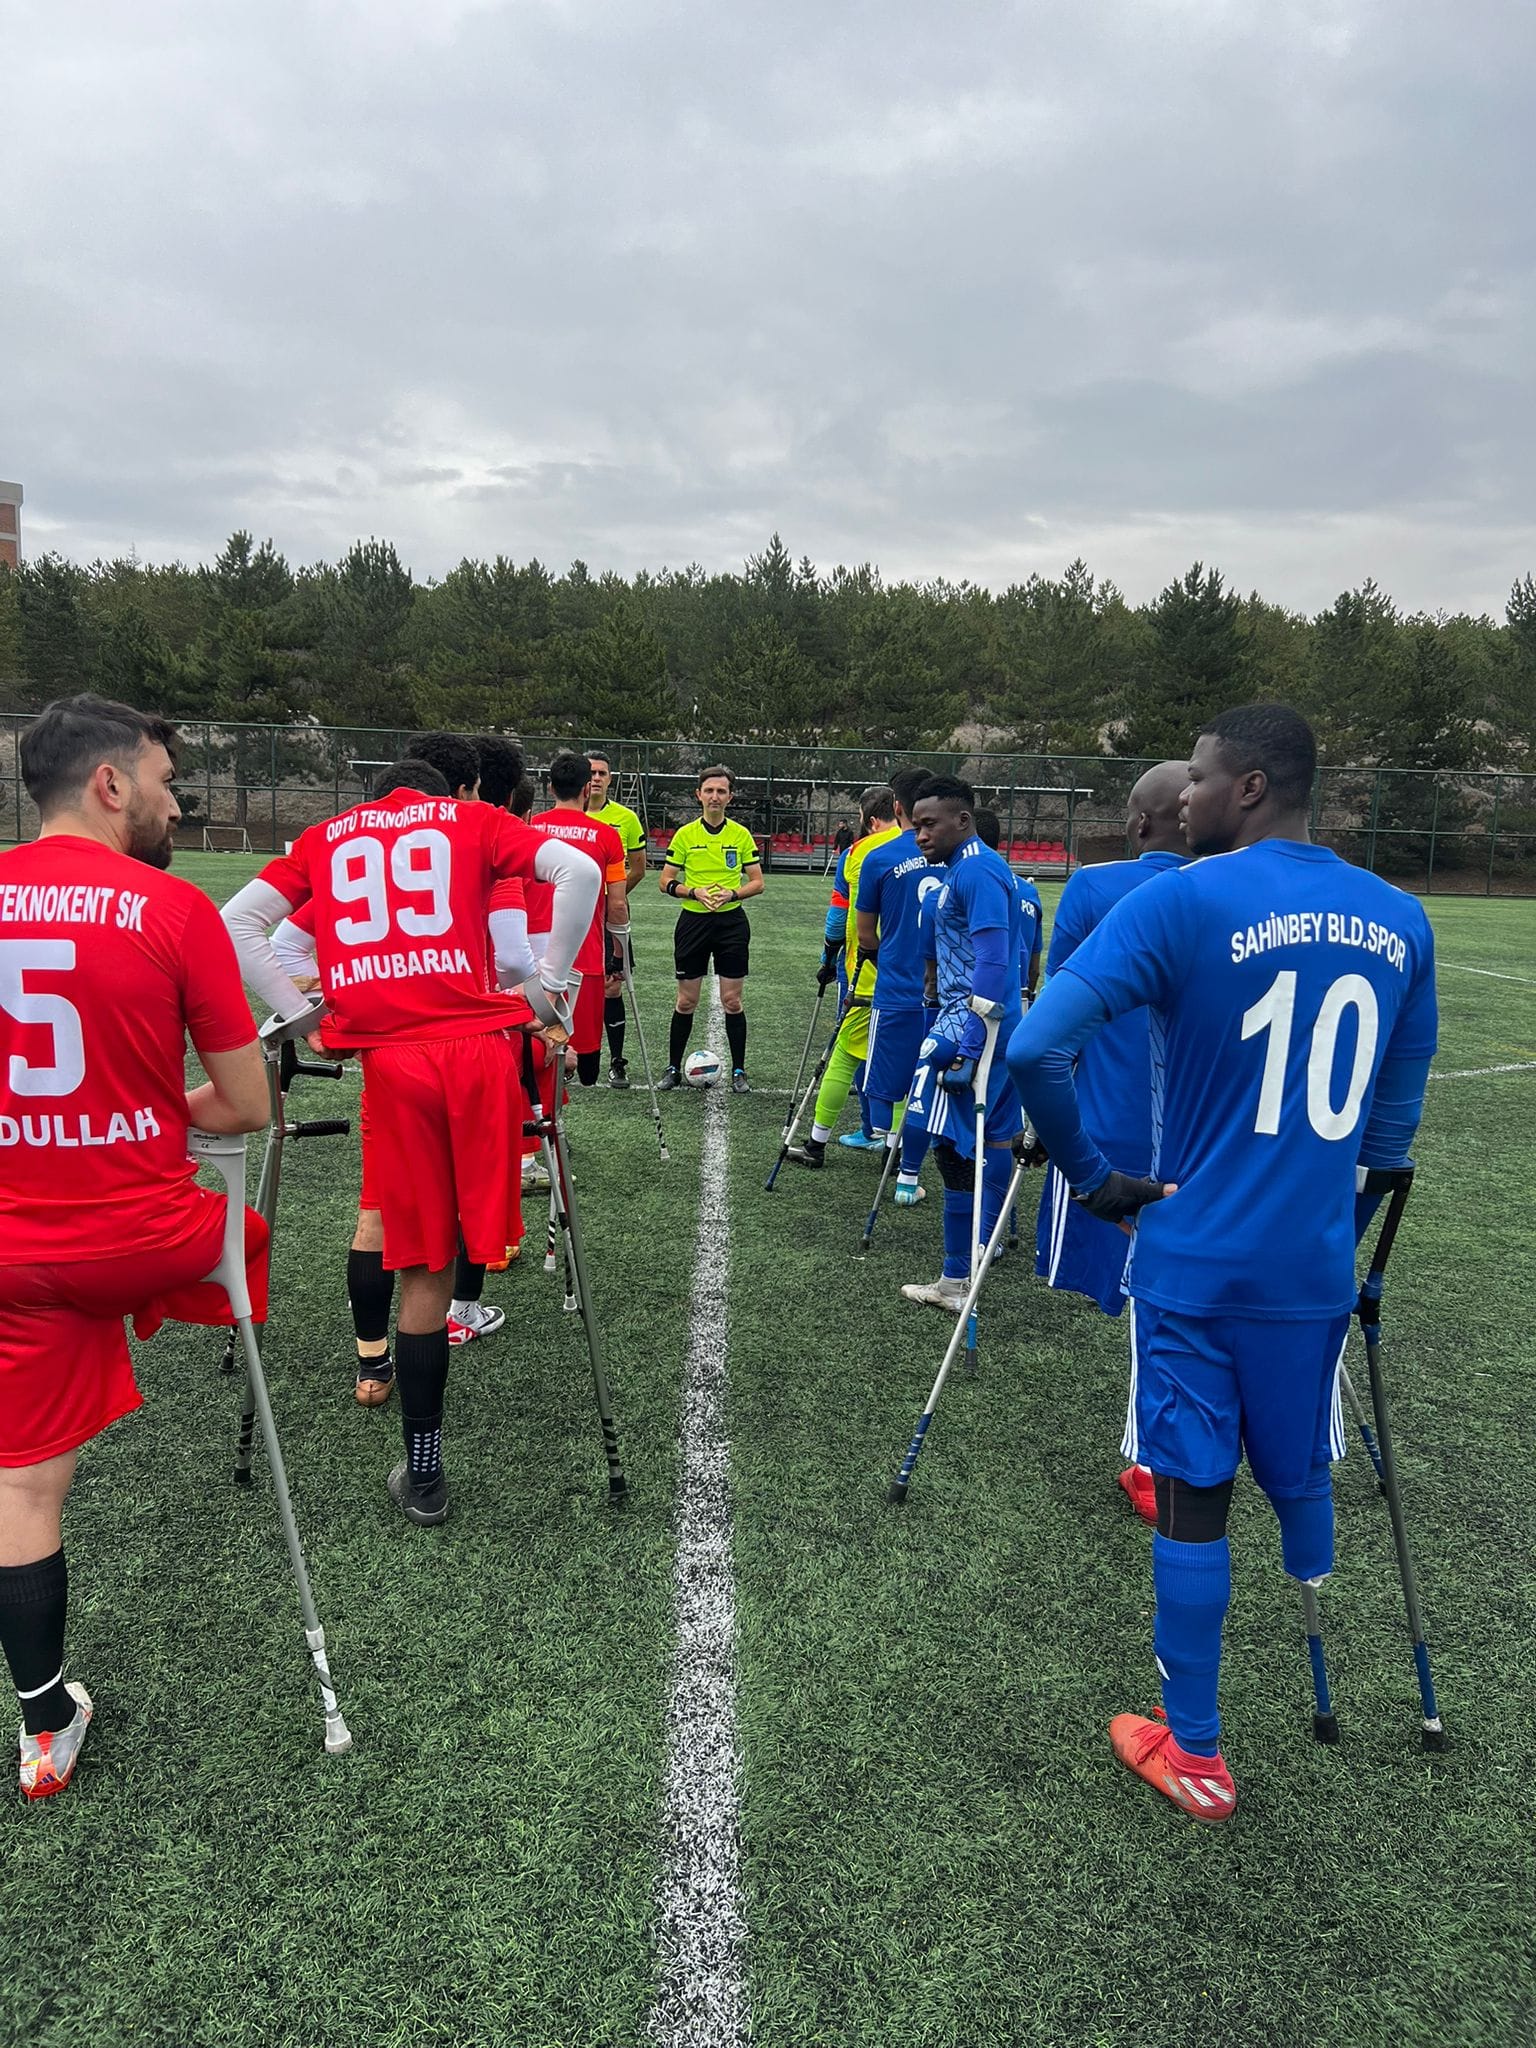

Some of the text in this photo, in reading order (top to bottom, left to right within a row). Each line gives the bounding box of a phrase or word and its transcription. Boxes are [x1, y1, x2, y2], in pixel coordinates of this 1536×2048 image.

[326, 801, 458, 842] ODTÜ TEKNOKENT SK
[547, 823, 587, 841] TEKNOKENT
[587, 828, 599, 843] SK
[331, 828, 454, 946] 99
[115, 890, 148, 932] SK
[1021, 899, 1035, 919] POR
[1327, 912, 1407, 973] BLD.SPOR
[330, 948, 472, 991] H.MUBARAK
[0, 938, 86, 1097] 5
[1240, 970, 1380, 1141] 10
[0, 1106, 161, 1148] DULLAH
